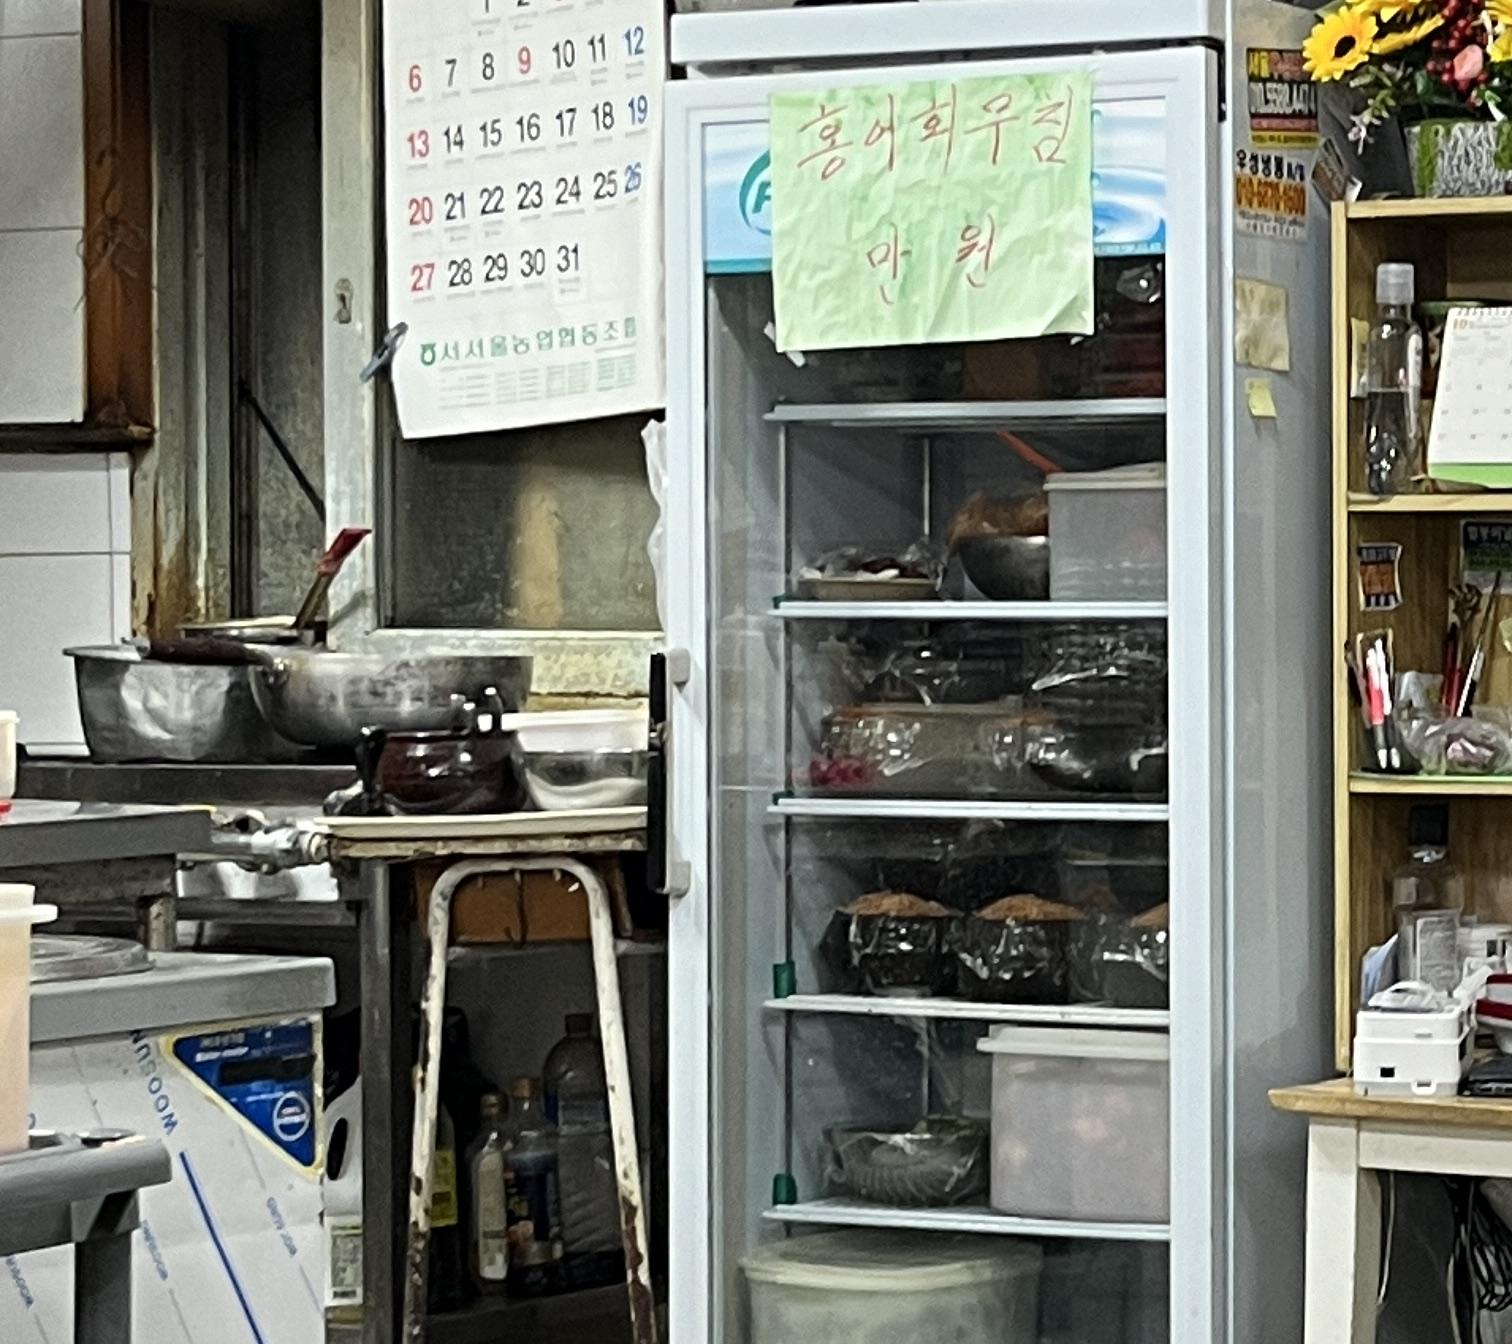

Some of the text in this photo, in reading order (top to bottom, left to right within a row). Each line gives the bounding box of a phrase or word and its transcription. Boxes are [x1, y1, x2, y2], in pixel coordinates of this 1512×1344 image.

[409, 26, 645, 93] 6 7 8 9 10 11 12
[407, 95, 648, 158] 13 14 15 16 17 18 19
[408, 197, 433, 226] 20
[444, 192, 466, 221] 21
[479, 186, 505, 216] 22
[517, 181, 543, 211] 23
[555, 175, 581, 205] 24
[593, 170, 618, 200] 25
[411, 243, 580, 292] 27 28 29 30 31
[129, 1030, 178, 1136] WOOSUN
